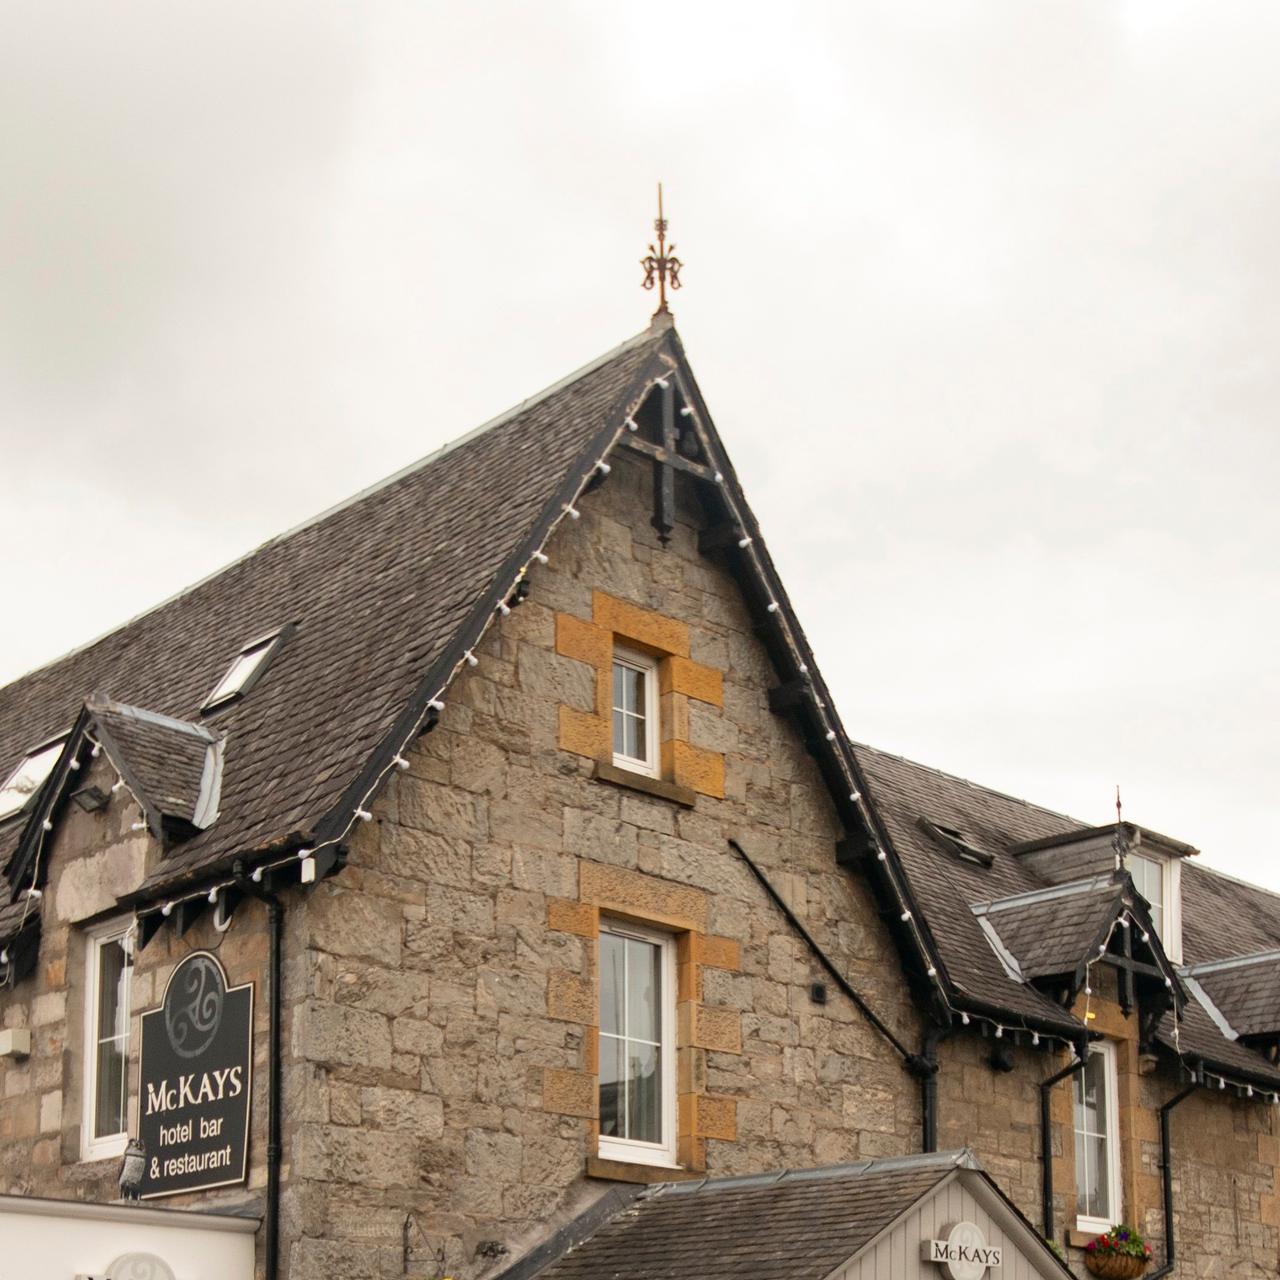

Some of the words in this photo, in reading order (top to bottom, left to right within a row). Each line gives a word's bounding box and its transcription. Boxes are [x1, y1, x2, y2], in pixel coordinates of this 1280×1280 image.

[146, 1066, 242, 1115] McKAYS
[160, 1121, 192, 1146] hotel
[200, 1117, 223, 1138] bar
[150, 1158, 160, 1179] &
[164, 1145, 231, 1176] restaurant
[934, 1242, 1001, 1265] McKAYS
